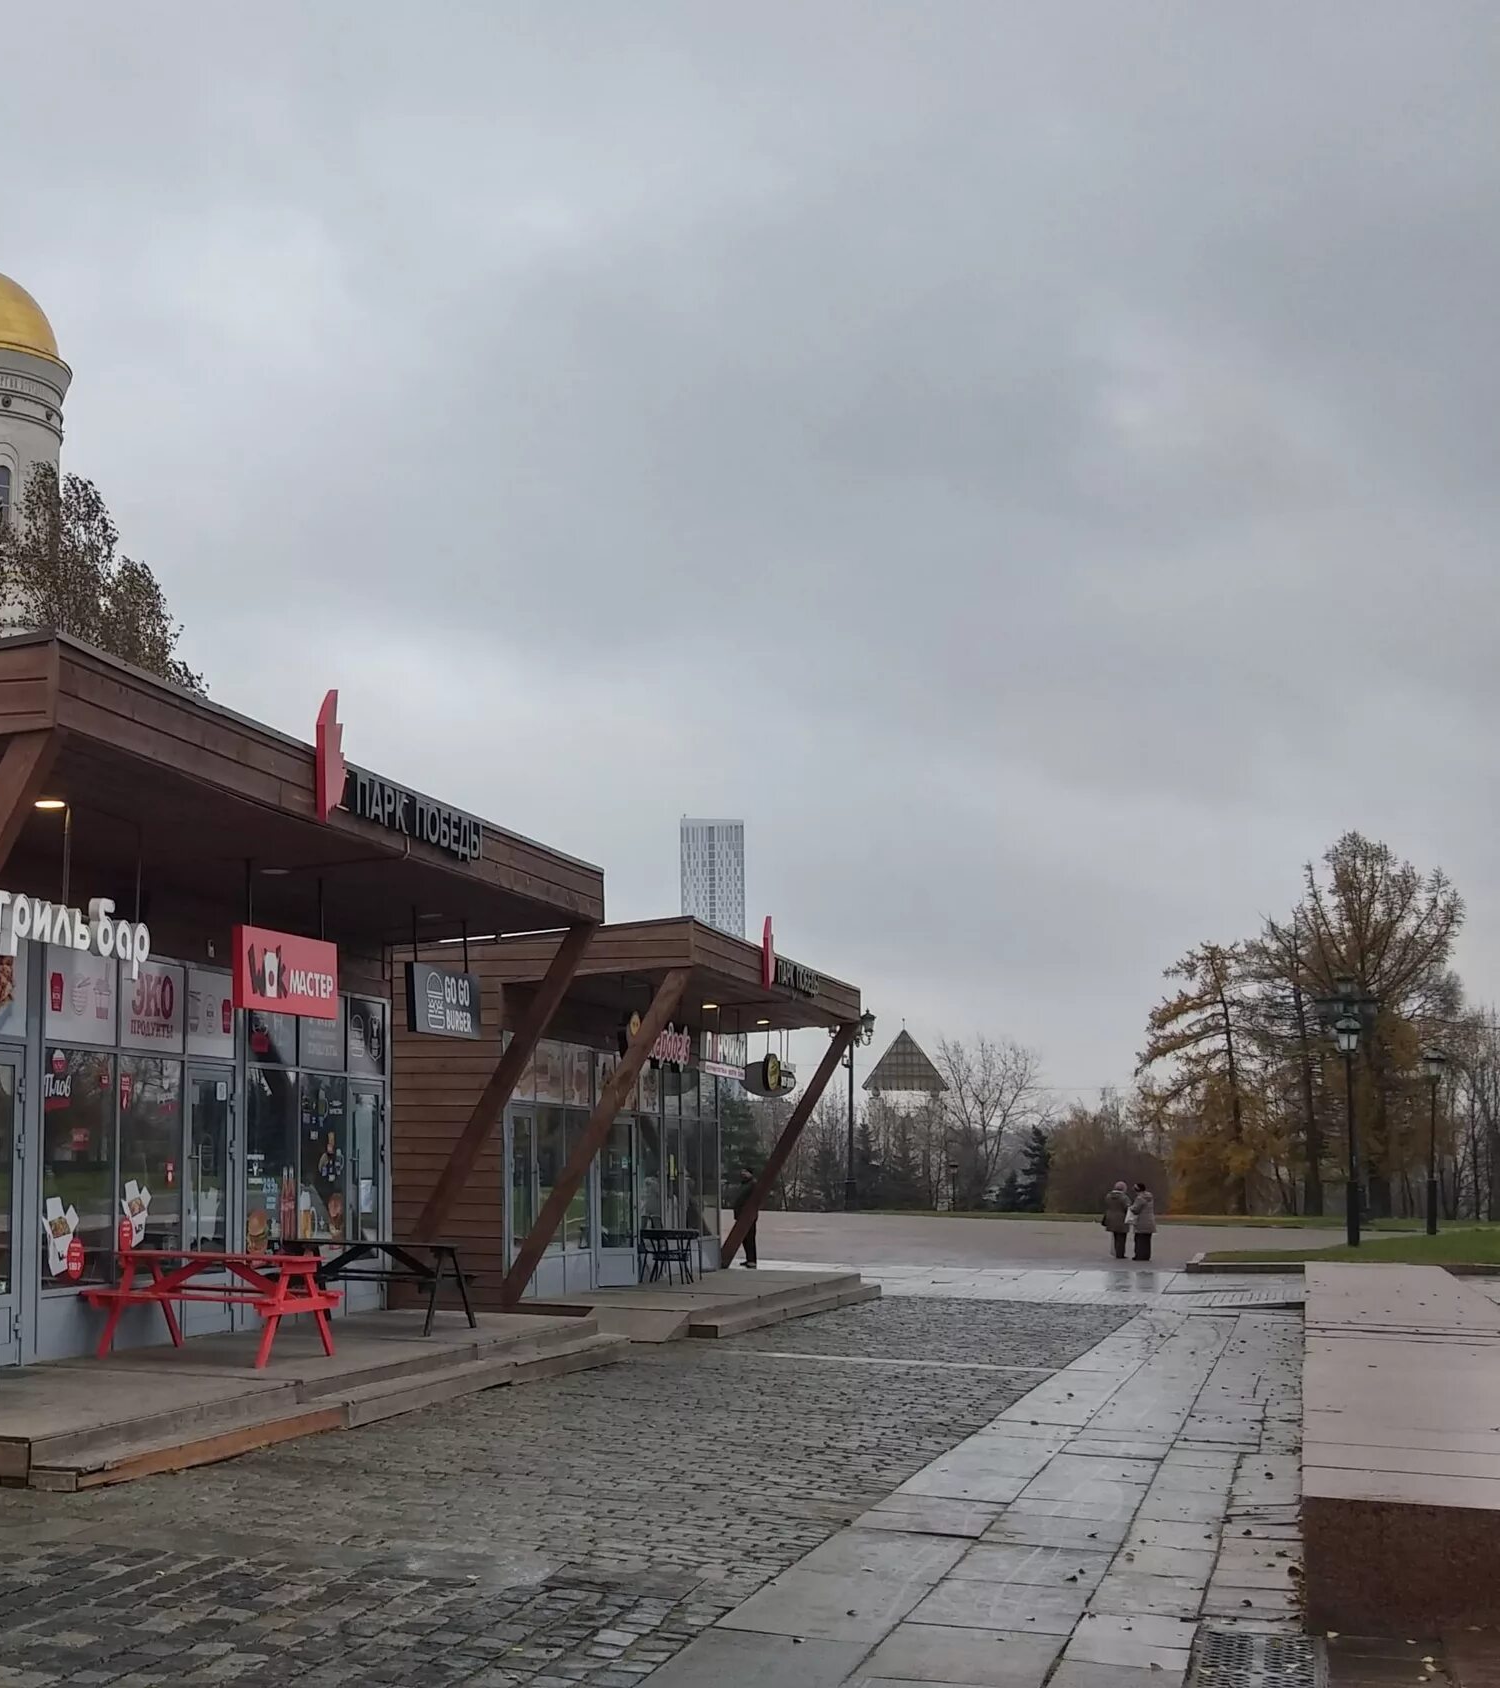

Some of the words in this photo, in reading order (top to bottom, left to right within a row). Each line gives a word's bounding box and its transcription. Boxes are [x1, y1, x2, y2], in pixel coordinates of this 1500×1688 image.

[355, 771, 409, 835] ПАРК
[415, 800, 483, 864] ПОБЕДЫ
[89, 897, 150, 980] бар
[132, 969, 174, 1020] ЭКО
[289, 969, 333, 999] МАСТЕР
[444, 975, 457, 1005] GO
[458, 978, 470, 1007] GO
[446, 1009, 472, 1033] BURGER
